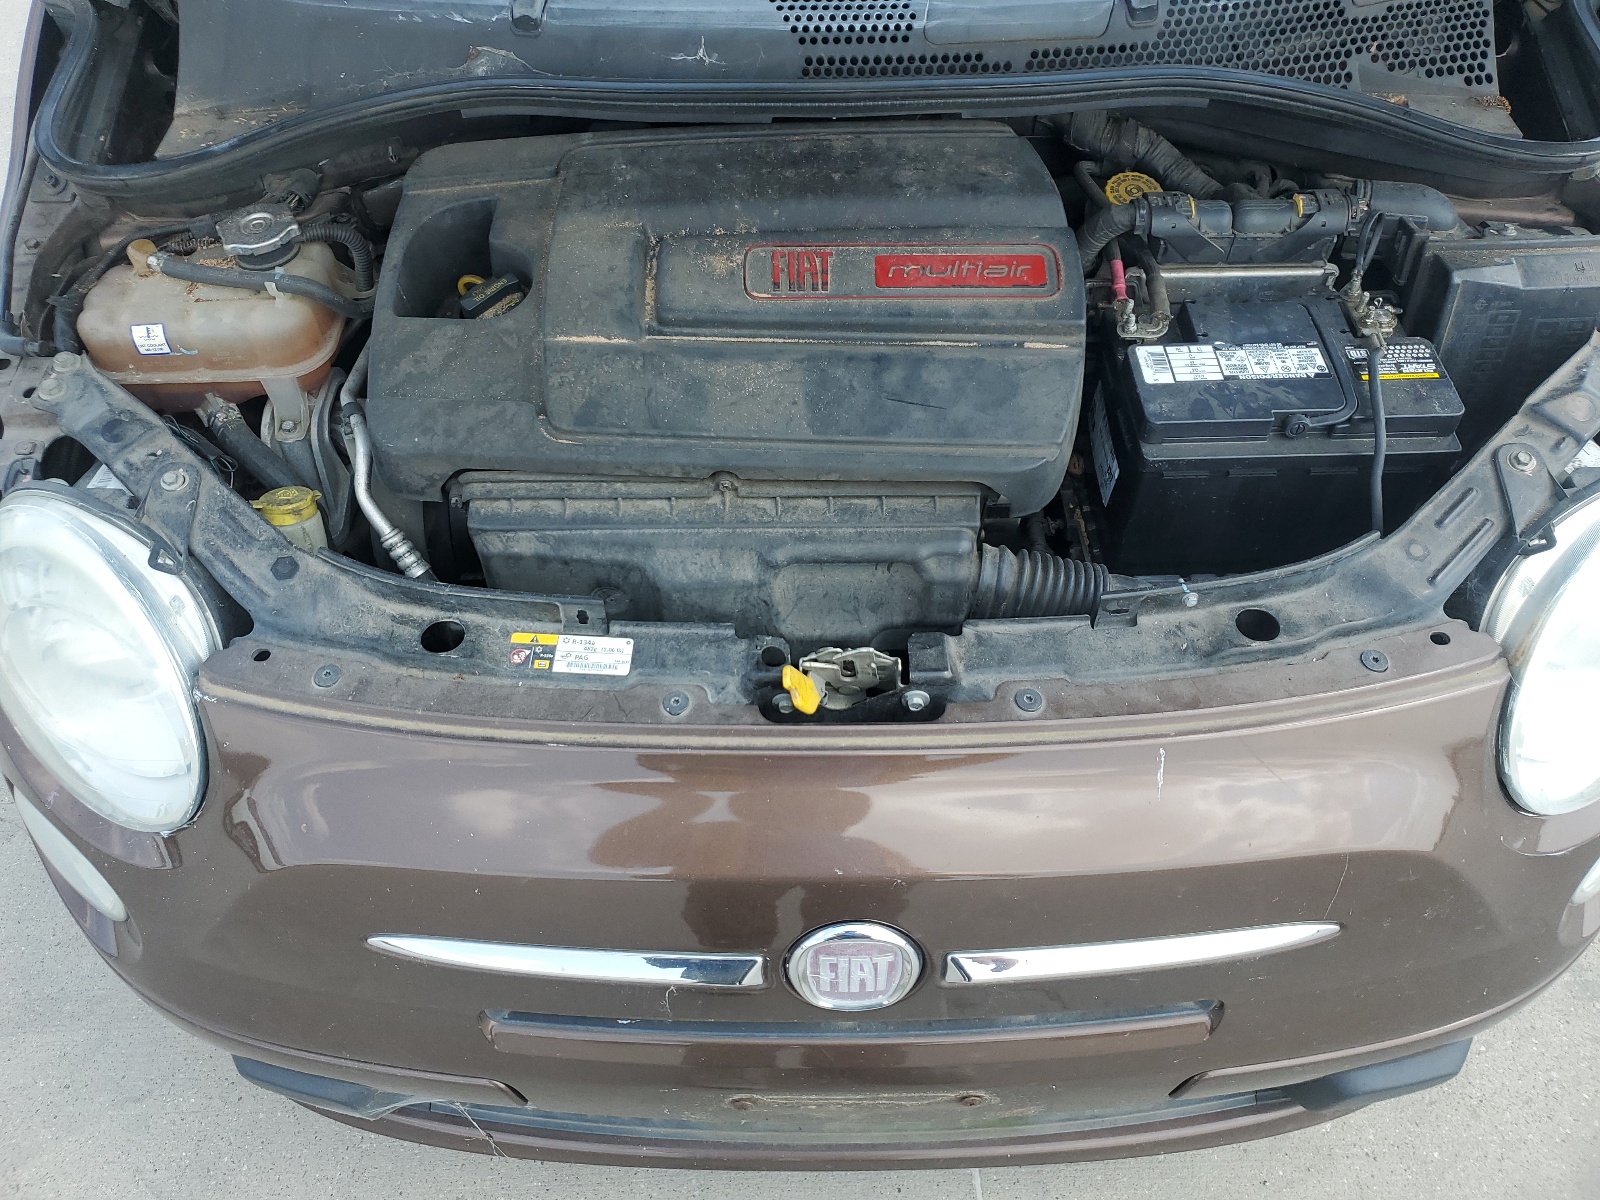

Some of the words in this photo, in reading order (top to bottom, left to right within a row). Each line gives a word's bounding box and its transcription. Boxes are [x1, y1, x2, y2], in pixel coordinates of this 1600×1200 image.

[771, 251, 833, 292] FIAT
[888, 260, 1032, 279] multiair
[472, 293, 485, 302] OIL
[484, 278, 508, 294] ENGINE
[819, 953, 894, 992] FIAT
